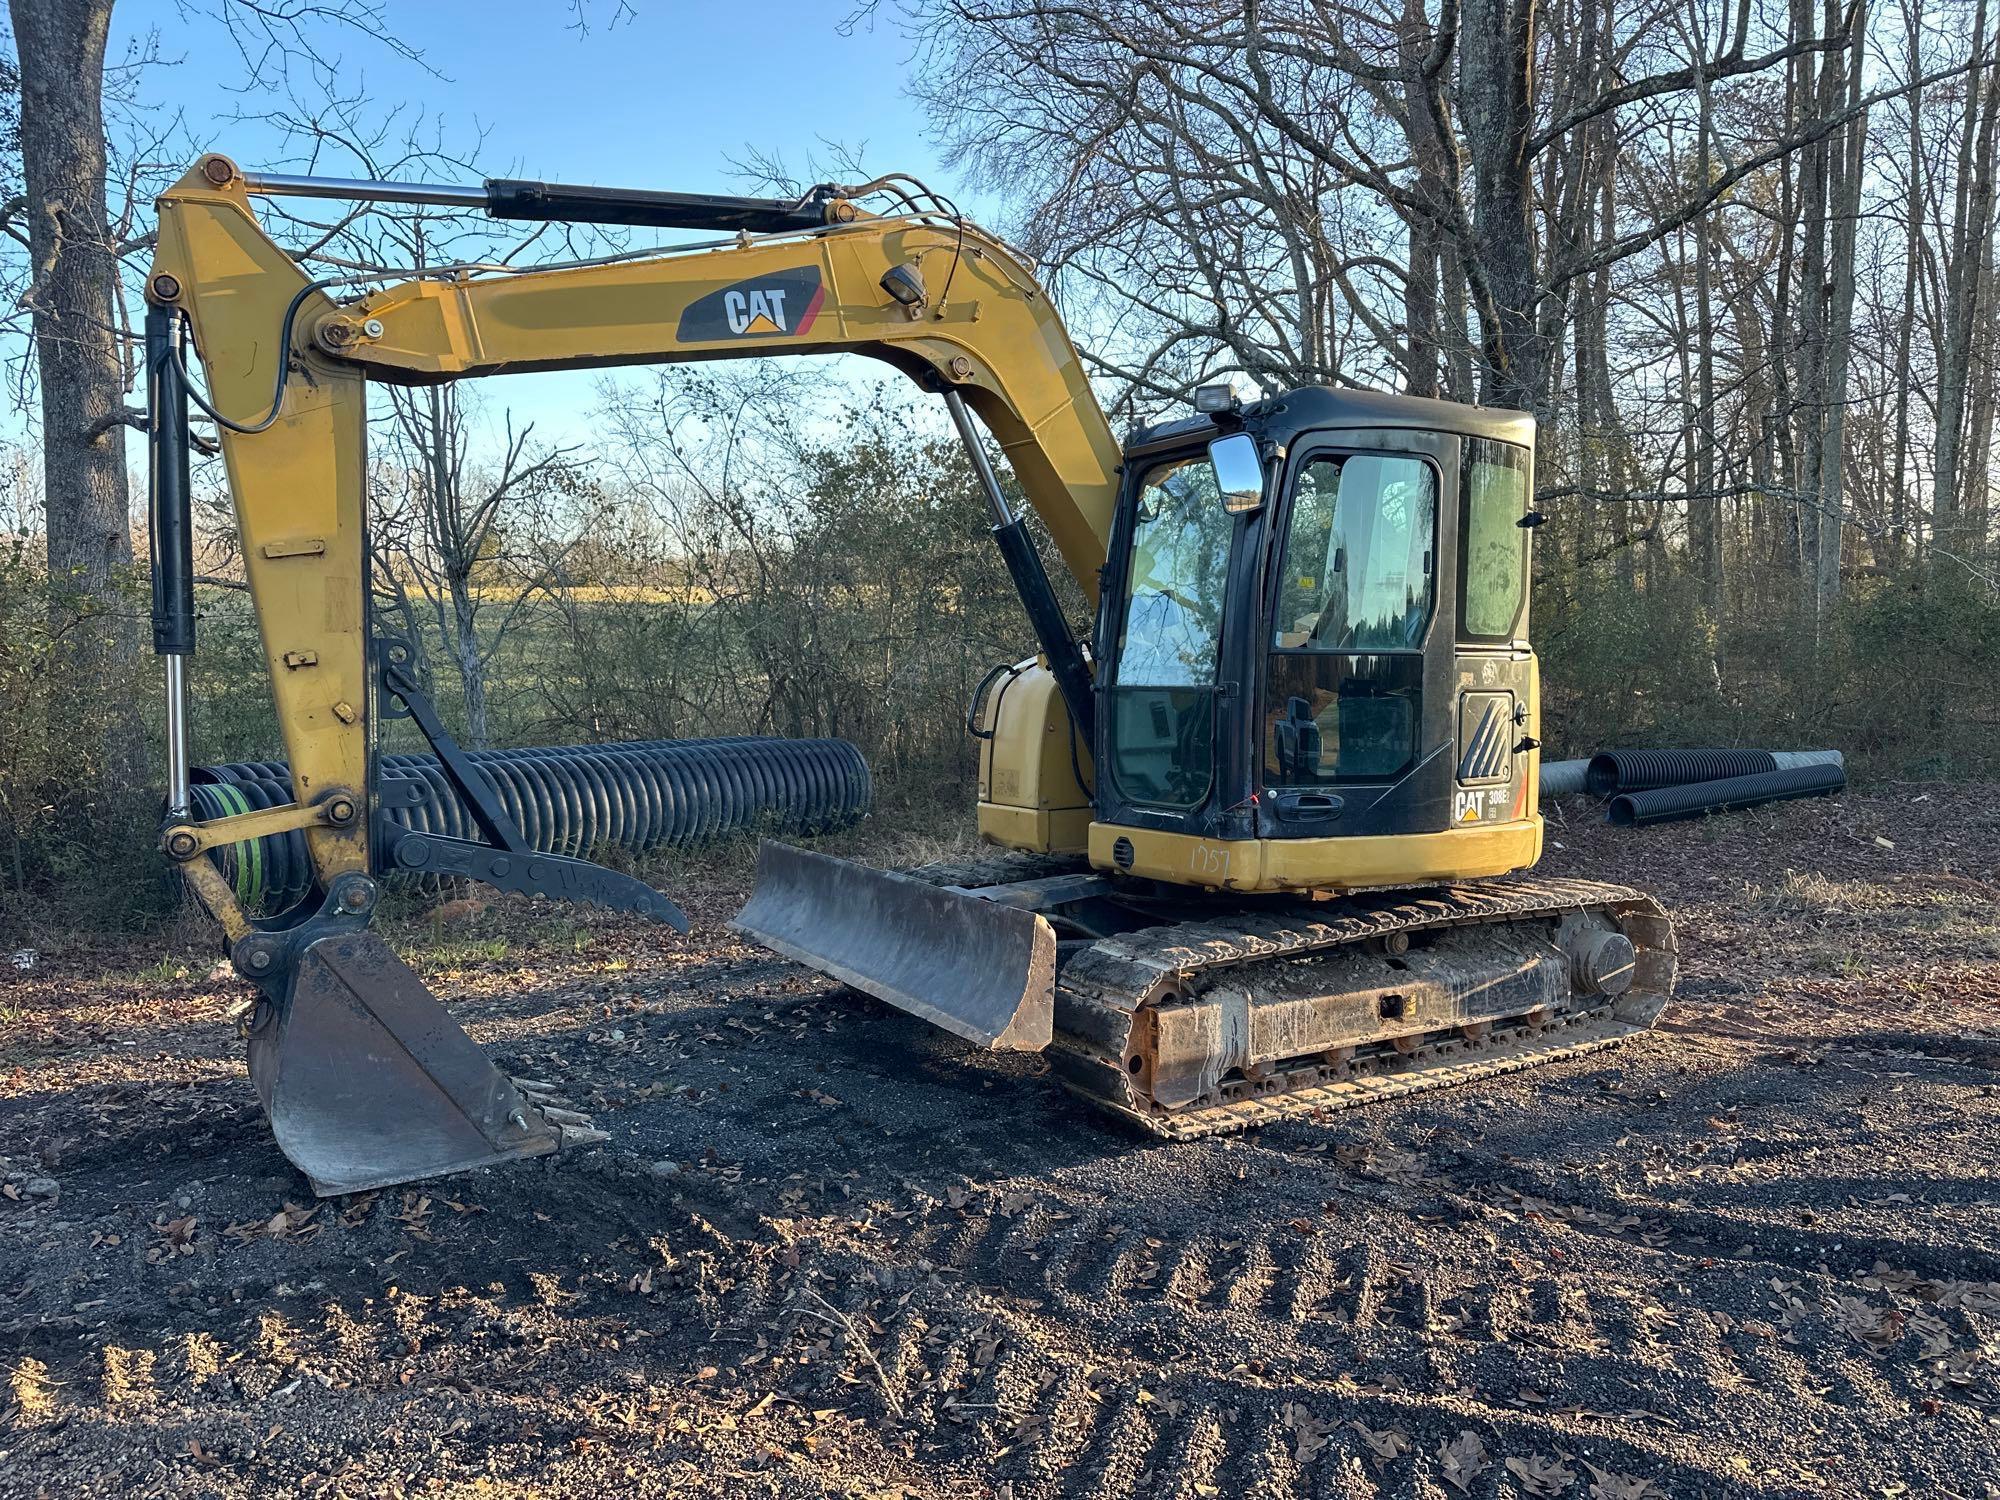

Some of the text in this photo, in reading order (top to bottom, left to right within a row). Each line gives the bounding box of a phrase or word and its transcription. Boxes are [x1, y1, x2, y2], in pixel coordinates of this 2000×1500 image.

[724, 289, 787, 334] CAT
[1455, 791, 1485, 822] CAT
[1191, 844, 1230, 880] 1757
